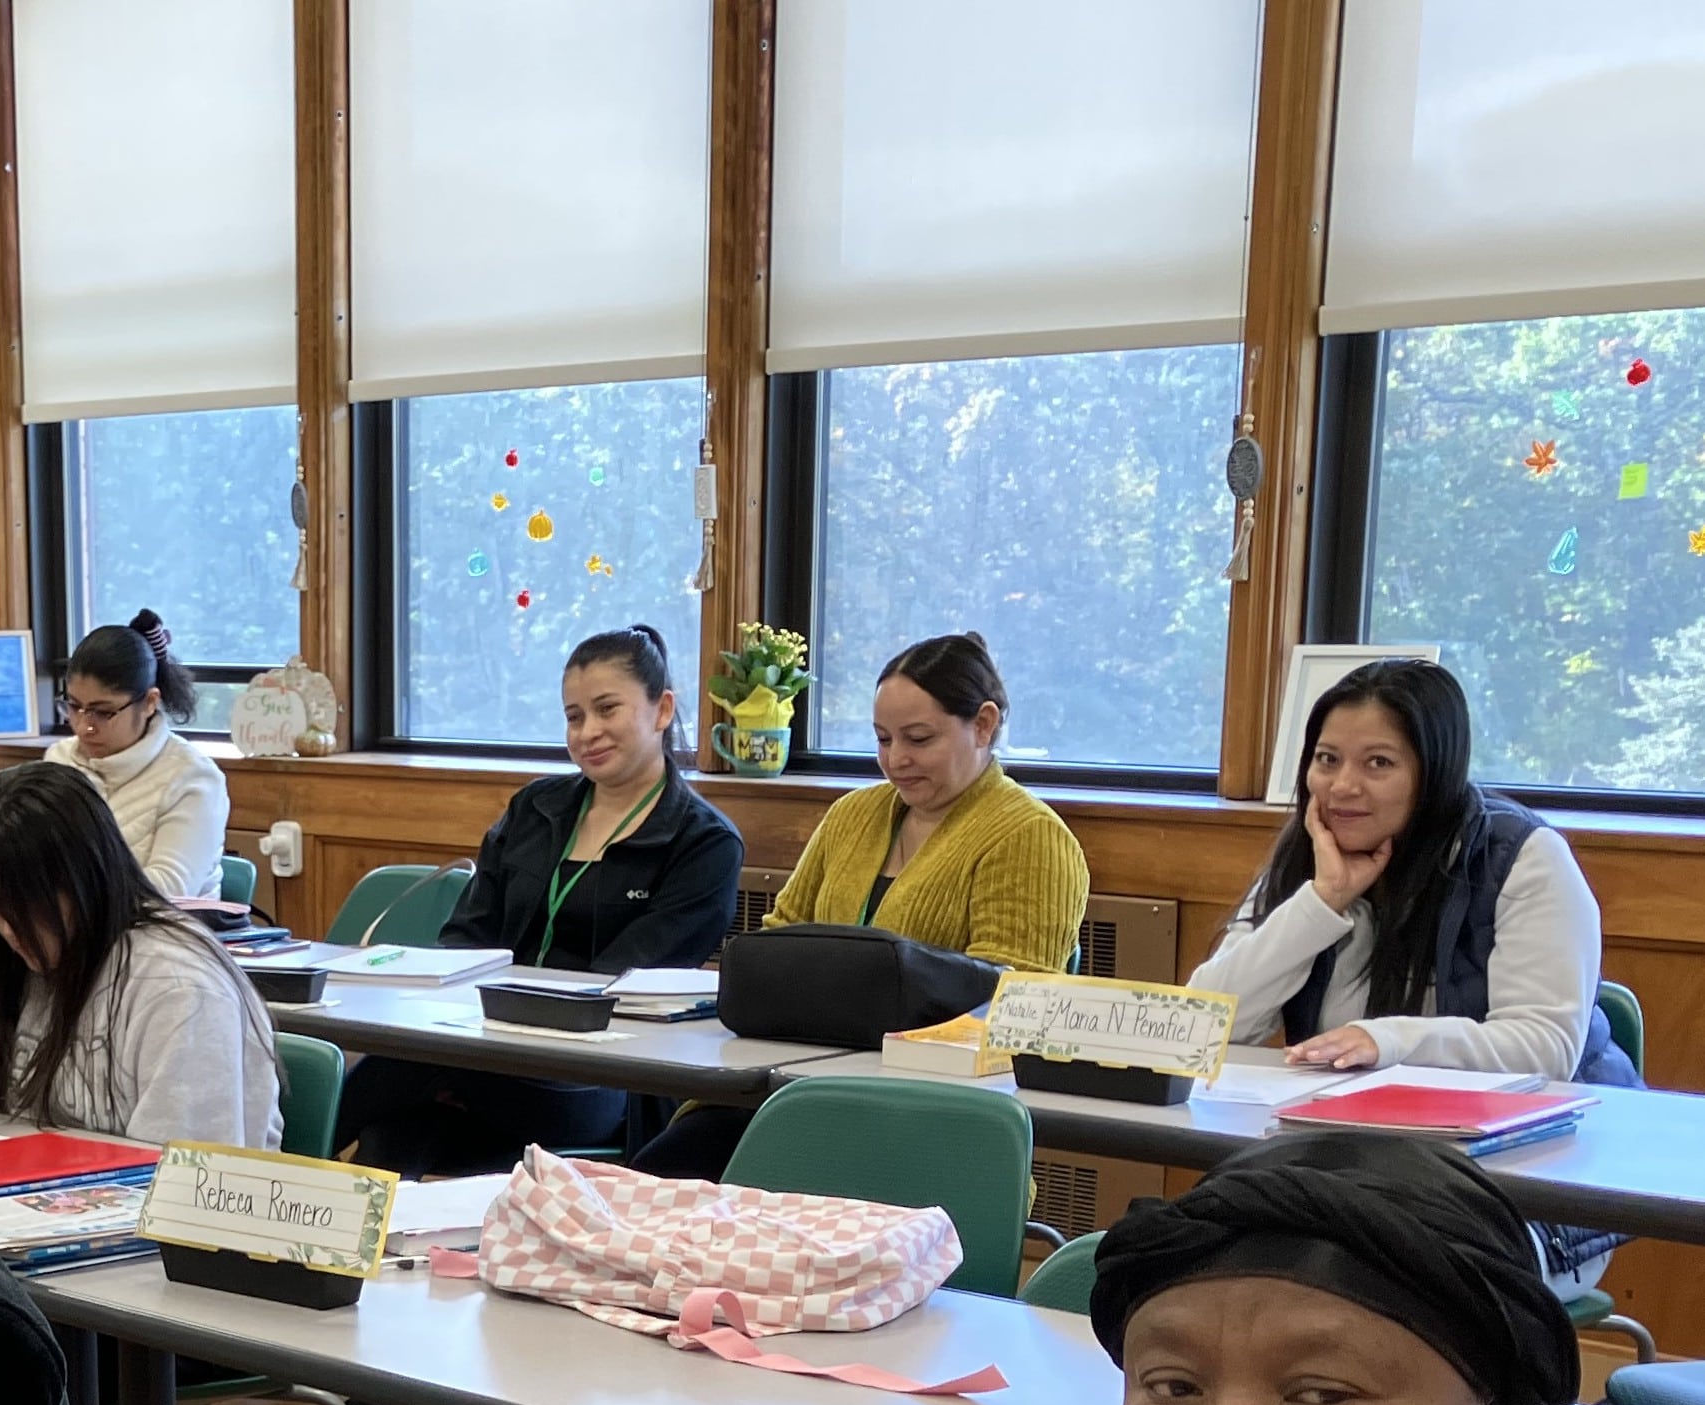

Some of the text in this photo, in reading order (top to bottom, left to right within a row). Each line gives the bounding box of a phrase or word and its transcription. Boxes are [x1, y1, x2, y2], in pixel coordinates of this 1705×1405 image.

[1107, 1000, 1124, 1034] N
[194, 1167, 333, 1227] Rebeca Romero
